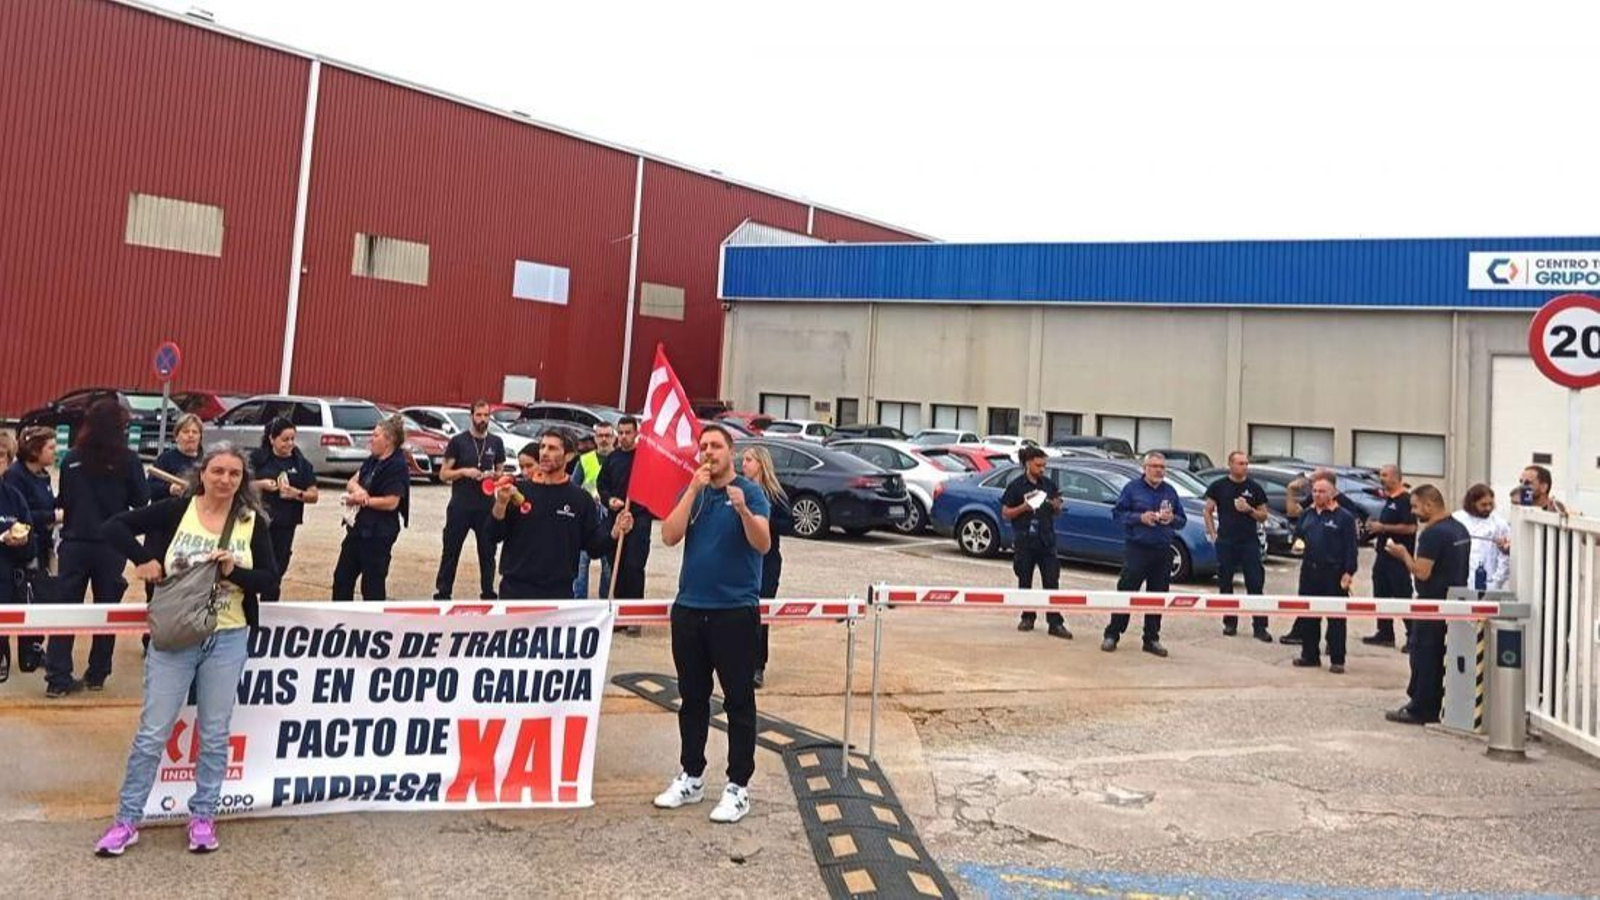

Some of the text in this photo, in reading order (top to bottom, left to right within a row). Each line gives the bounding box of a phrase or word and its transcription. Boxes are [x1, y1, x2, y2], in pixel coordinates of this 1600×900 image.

[1535, 259, 1588, 269] CENTRO
[1535, 271, 1600, 285] GRUPO
[1549, 324, 1600, 359] 20
[247, 623, 600, 660] DICIÓNS DE TRABALLO
[312, 668, 355, 704] EN
[369, 667, 459, 704] COPO
[472, 668, 592, 703] GALICIA
[276, 717, 450, 759] PACTO DE
[445, 716, 588, 802] XA!
[272, 773, 441, 808] EMPRESA
